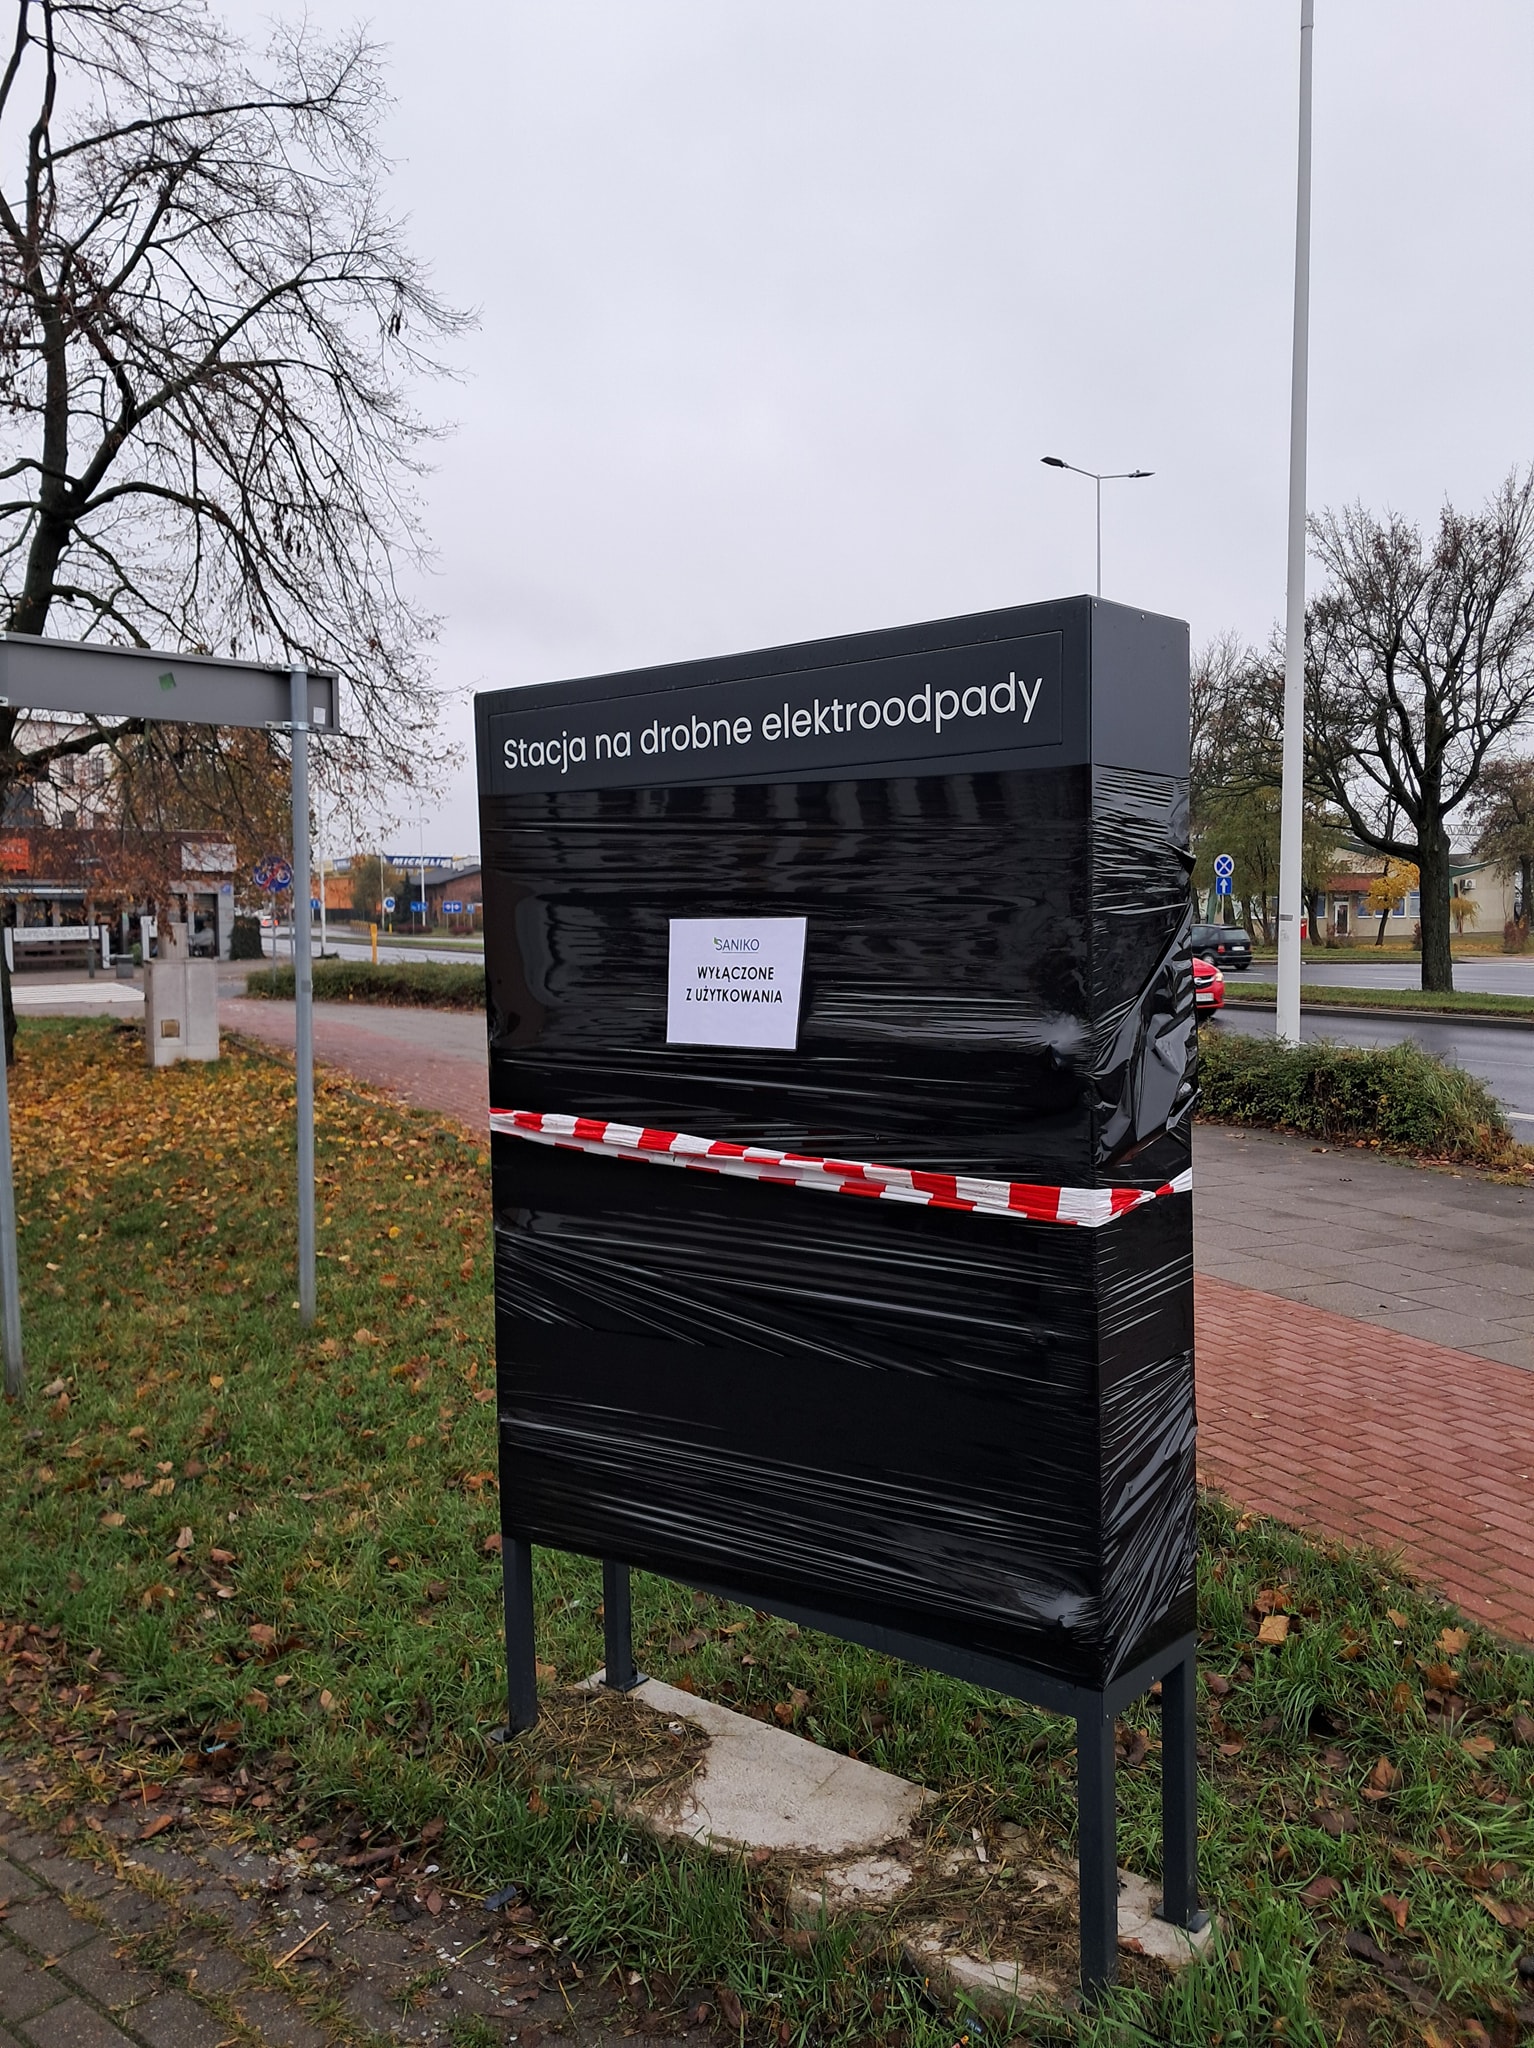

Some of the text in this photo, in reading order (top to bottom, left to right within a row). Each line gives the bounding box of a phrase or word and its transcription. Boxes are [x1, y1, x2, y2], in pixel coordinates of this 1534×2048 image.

[503, 671, 1043, 774] Stacja na drobne elektroodpady
[392, 857, 446, 867] MICHELI
[714, 938, 760, 951] SANIKO
[697, 966, 774, 982] WYŁĄCZONE
[686, 985, 783, 1003] Z UŻYTKOWANIA
